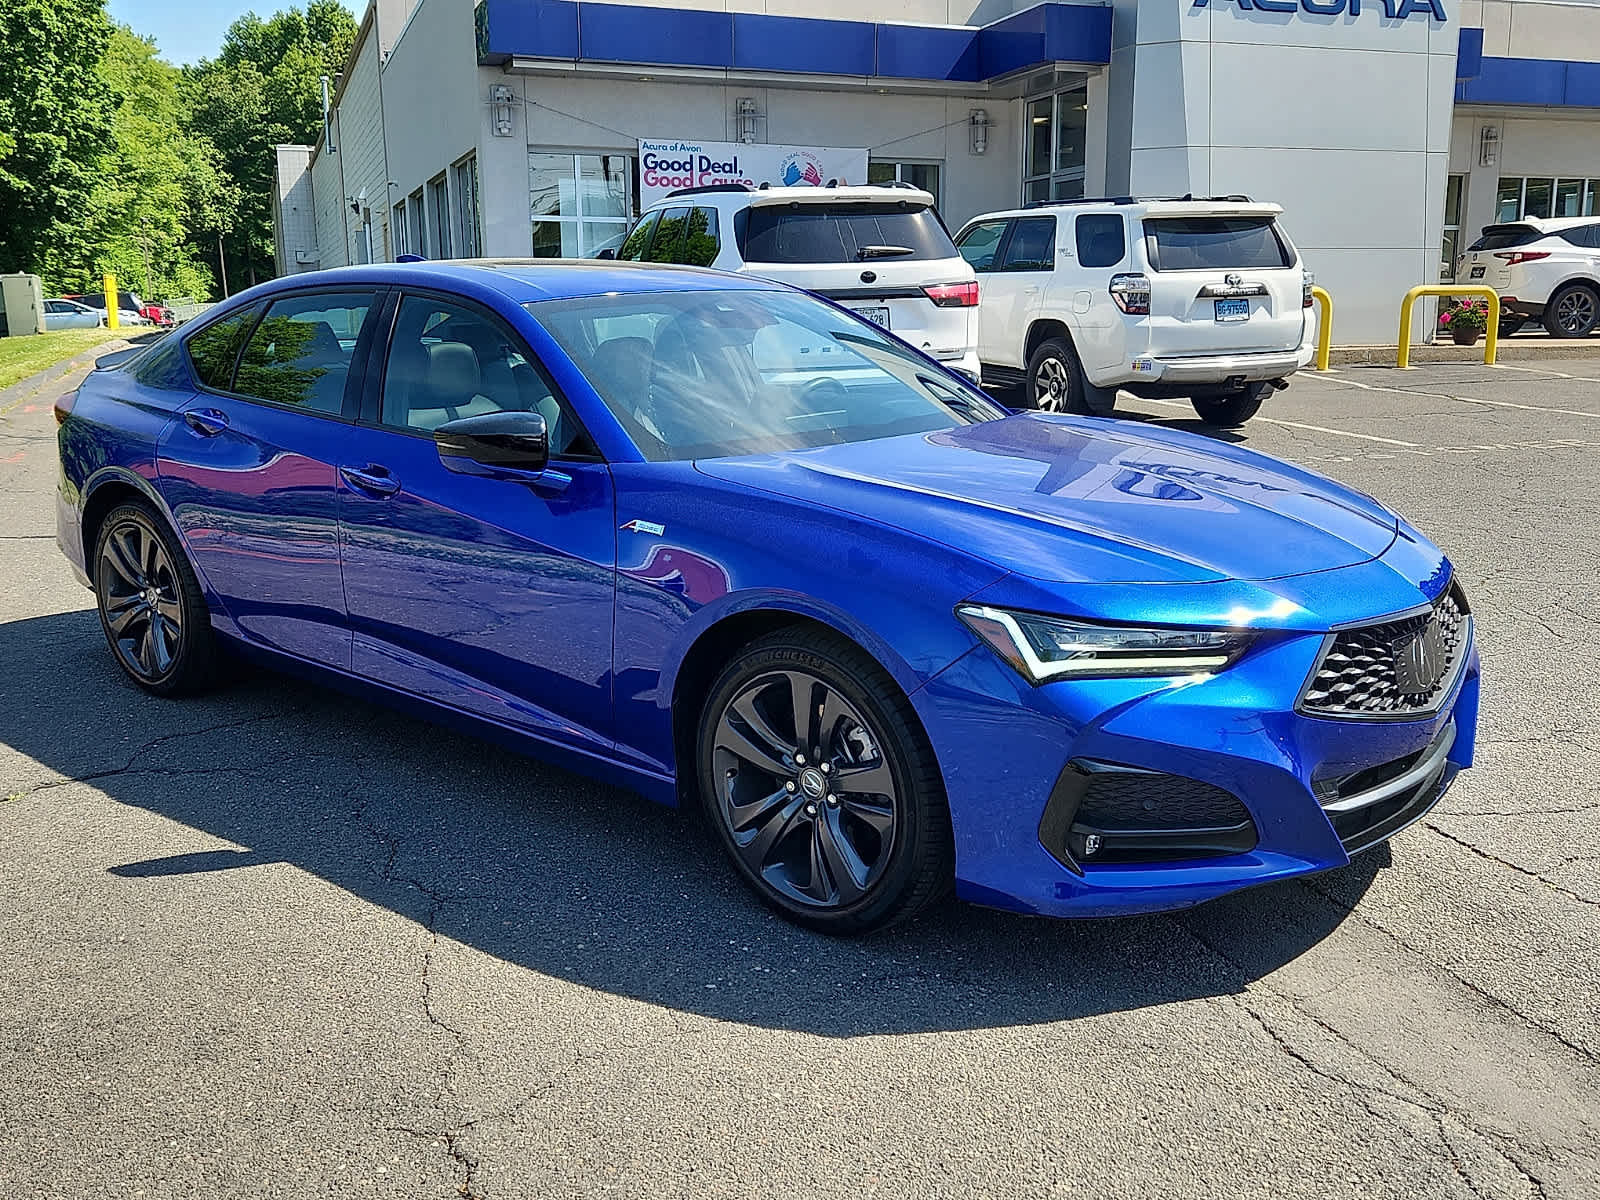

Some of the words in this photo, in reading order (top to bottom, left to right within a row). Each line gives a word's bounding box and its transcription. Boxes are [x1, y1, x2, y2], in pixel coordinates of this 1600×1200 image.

[642, 142, 668, 151] Acura
[669, 143, 679, 151] of
[680, 144, 702, 152] Avon
[643, 153, 694, 172] Good
[698, 155, 743, 177] Deal,
[643, 169, 694, 188] Good
